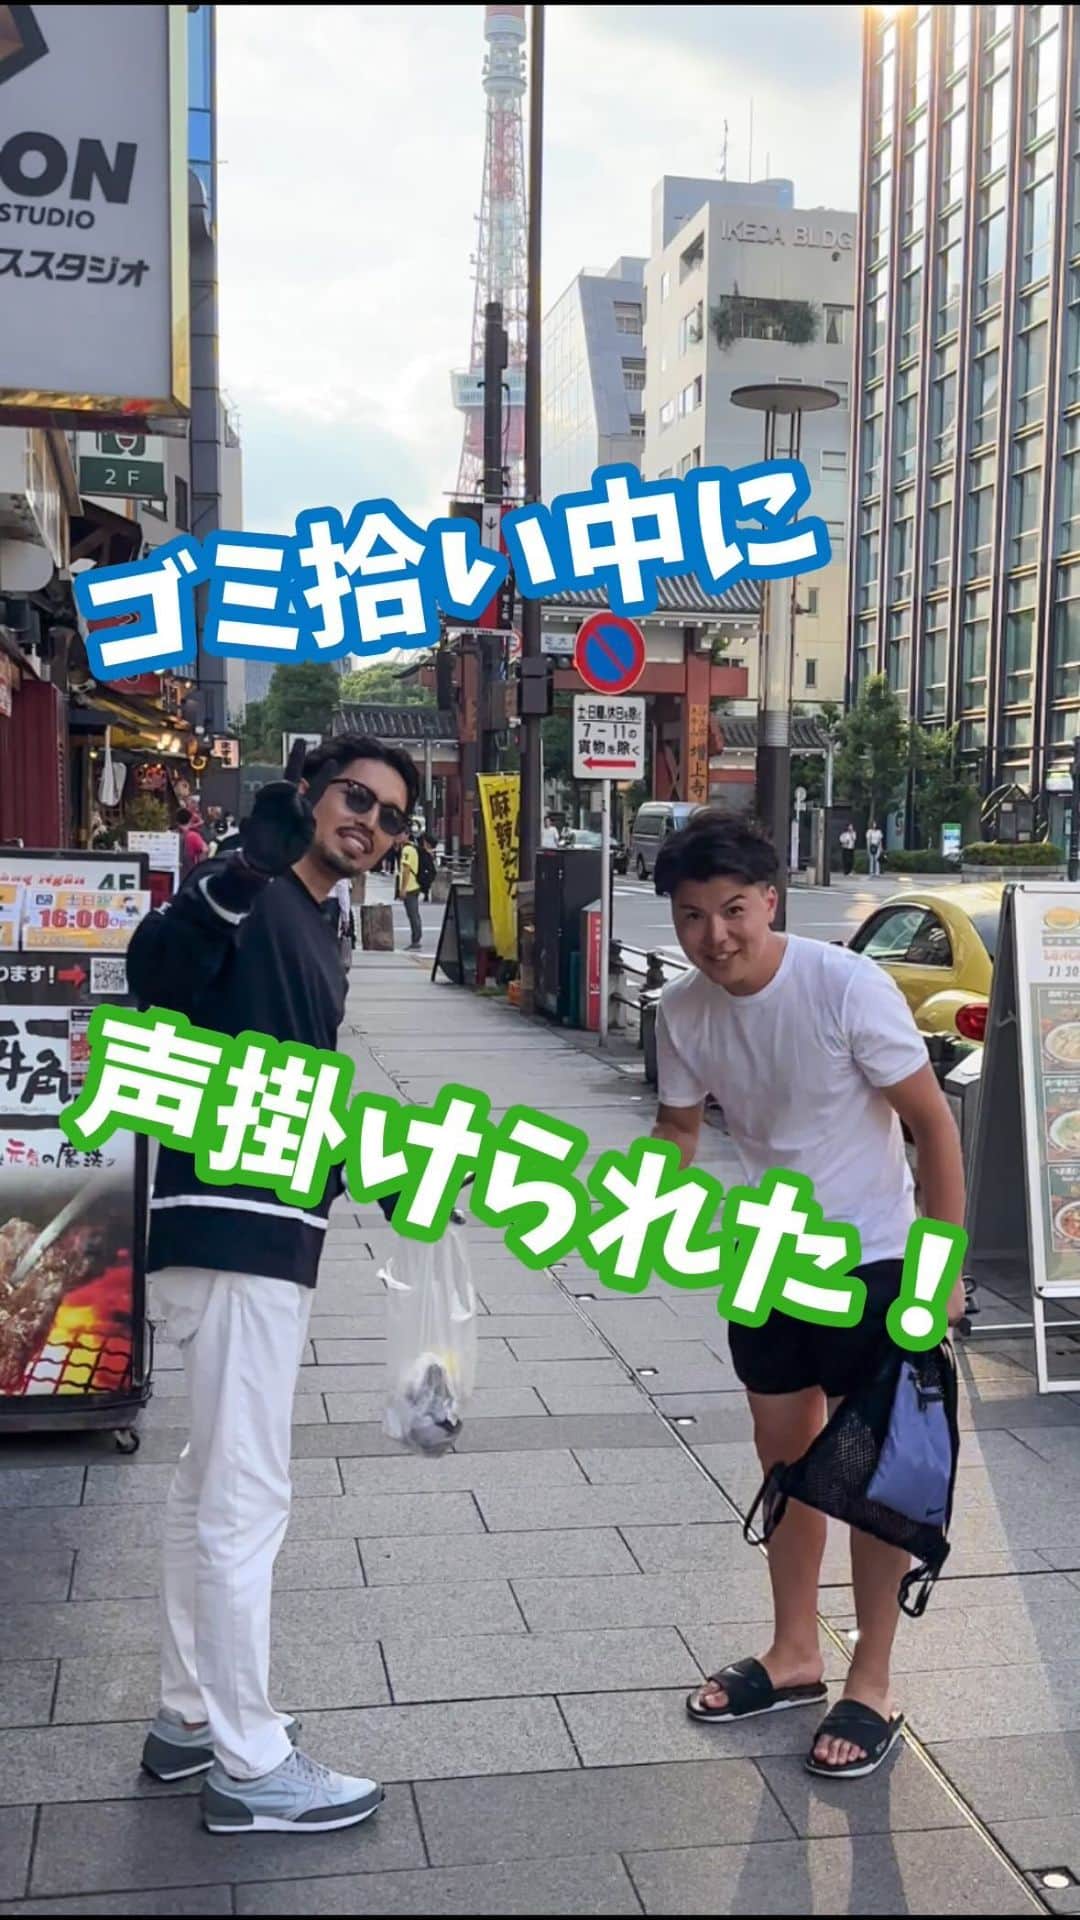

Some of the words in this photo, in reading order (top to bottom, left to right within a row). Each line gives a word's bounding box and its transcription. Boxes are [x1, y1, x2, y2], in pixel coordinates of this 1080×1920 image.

[0, 131, 138, 205] ON
[0, 203, 95, 229] STUDIO
[721, 219, 786, 247] IKEDA
[793, 226, 854, 251] BLDG
[0, 247, 150, 288] ススタジオ
[578, 738, 641, 757] 貨物を除く
[39, 908, 109, 930] 16:00
